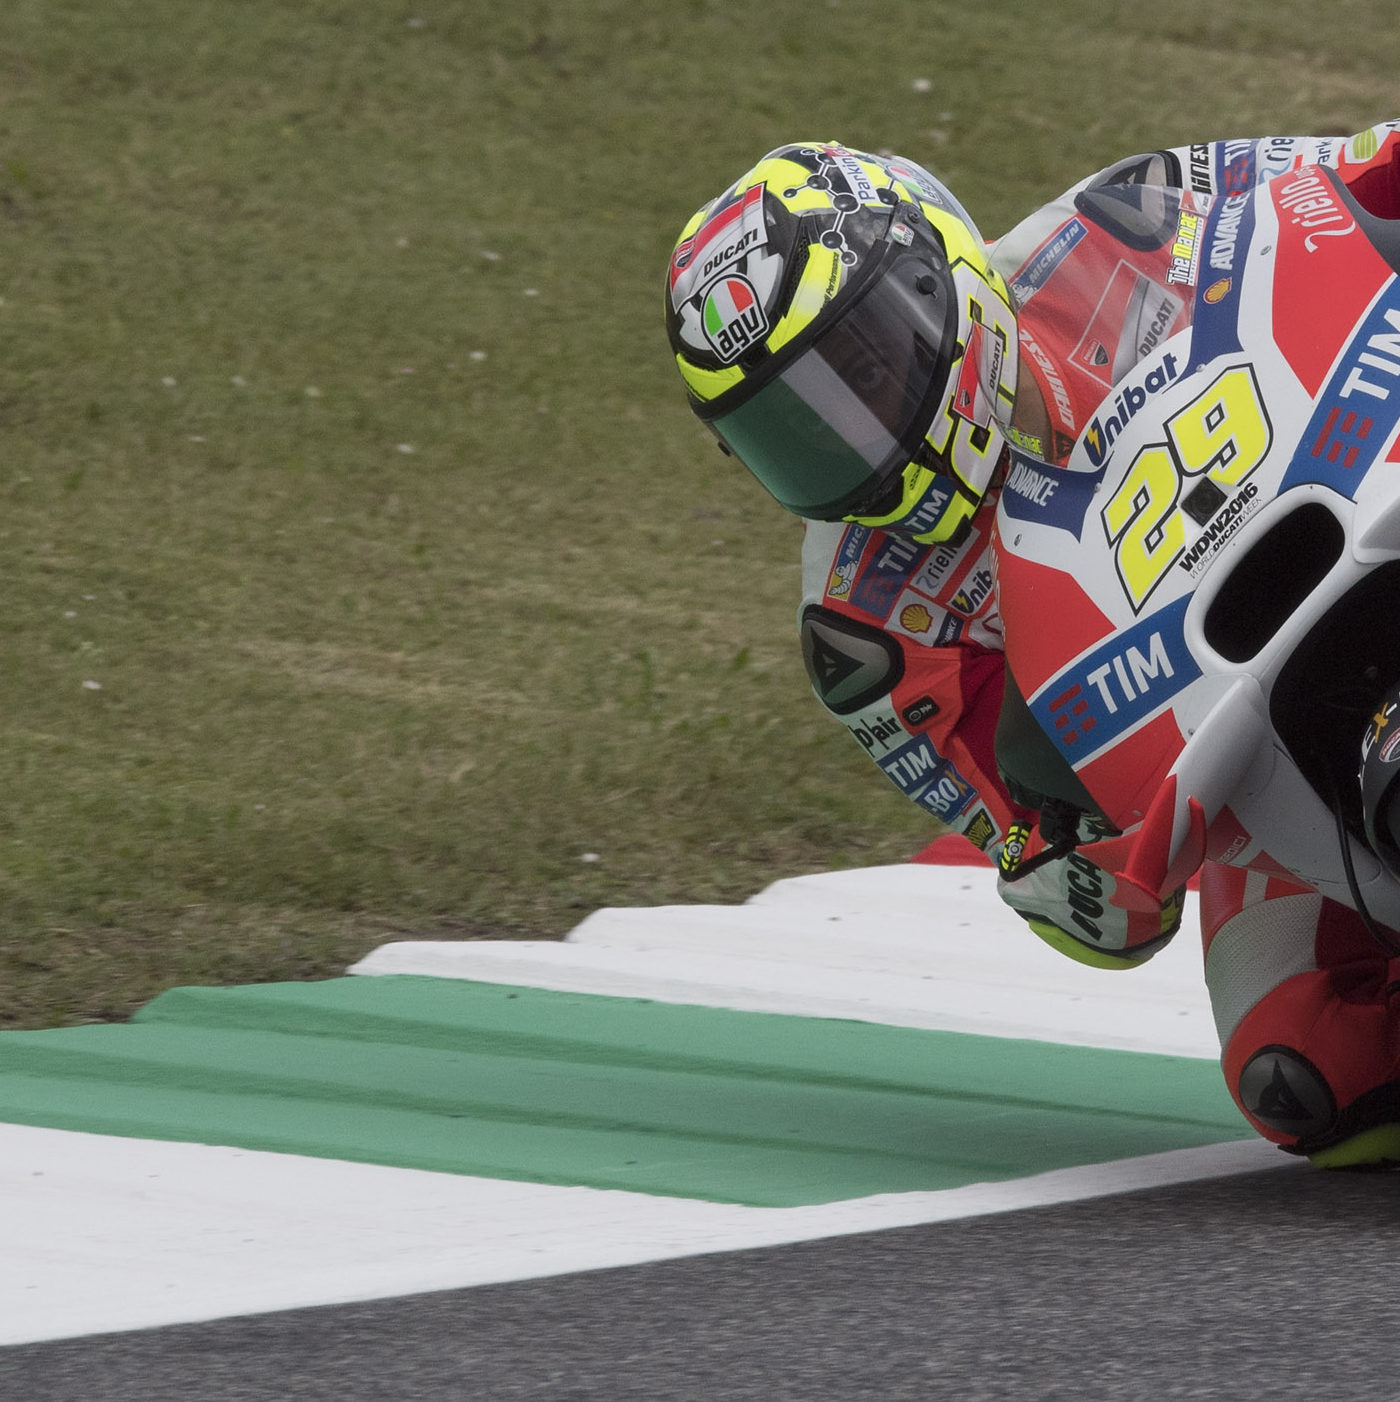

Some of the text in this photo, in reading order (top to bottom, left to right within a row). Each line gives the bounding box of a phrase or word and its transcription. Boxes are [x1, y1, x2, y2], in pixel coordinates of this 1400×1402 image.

[703, 228, 758, 278] DUCATI
[1029, 222, 1080, 284] MICHELIN
[1210, 191, 1250, 271] ADVANCE
[717, 306, 761, 356] agv
[1138, 297, 1176, 357] DUCATI
[989, 340, 1003, 391] DUCATI
[1083, 352, 1178, 467] Unibat
[904, 489, 949, 531] TIM
[1007, 462, 1060, 507] ADVANCE
[1100, 362, 1273, 617] 29
[1178, 482, 1259, 573] WDW2016
[1086, 631, 1175, 714] TIM
[884, 743, 937, 788] TIM
